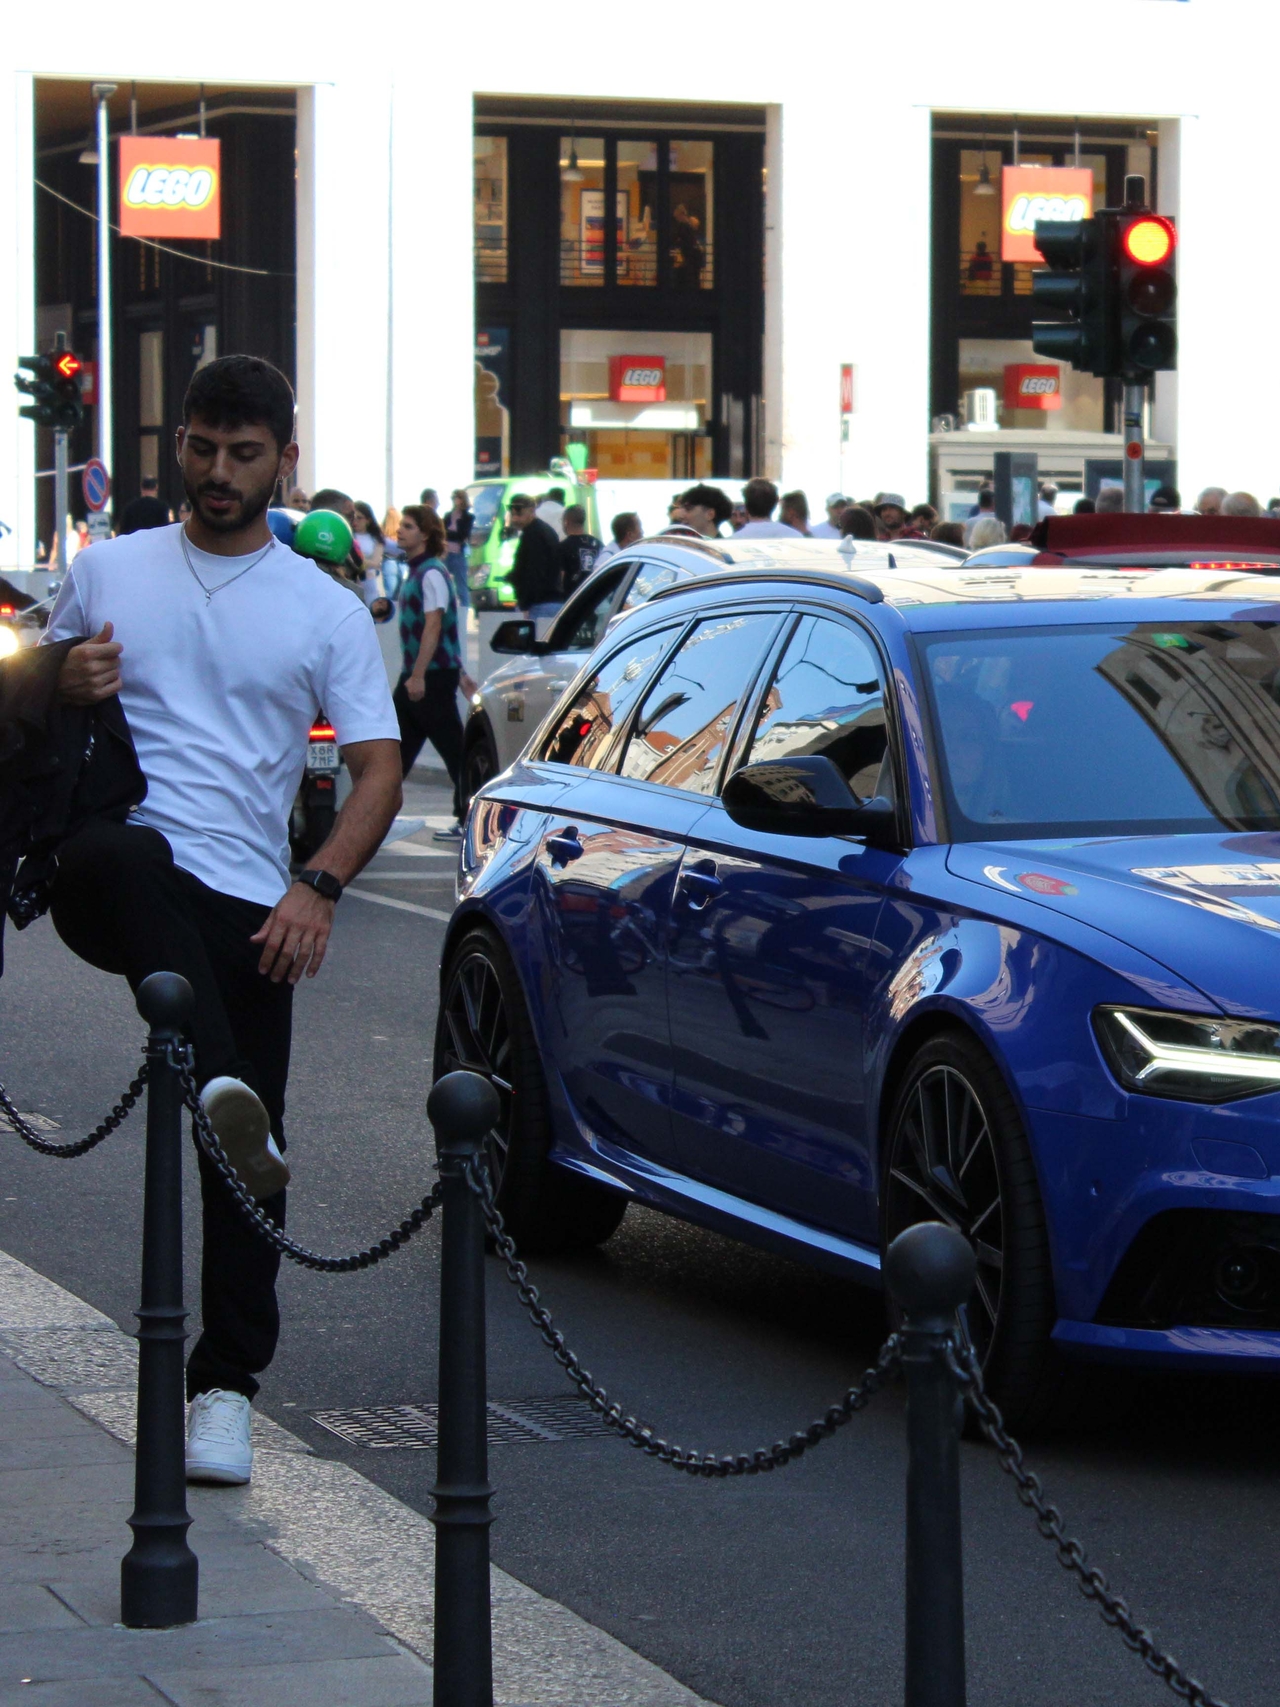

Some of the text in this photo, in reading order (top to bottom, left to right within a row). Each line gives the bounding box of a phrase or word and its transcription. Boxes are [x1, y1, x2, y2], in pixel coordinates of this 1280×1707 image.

[126, 167, 213, 207] LEGO
[623, 369, 662, 386] LEGO
[1020, 377, 1057, 395] LEGO
